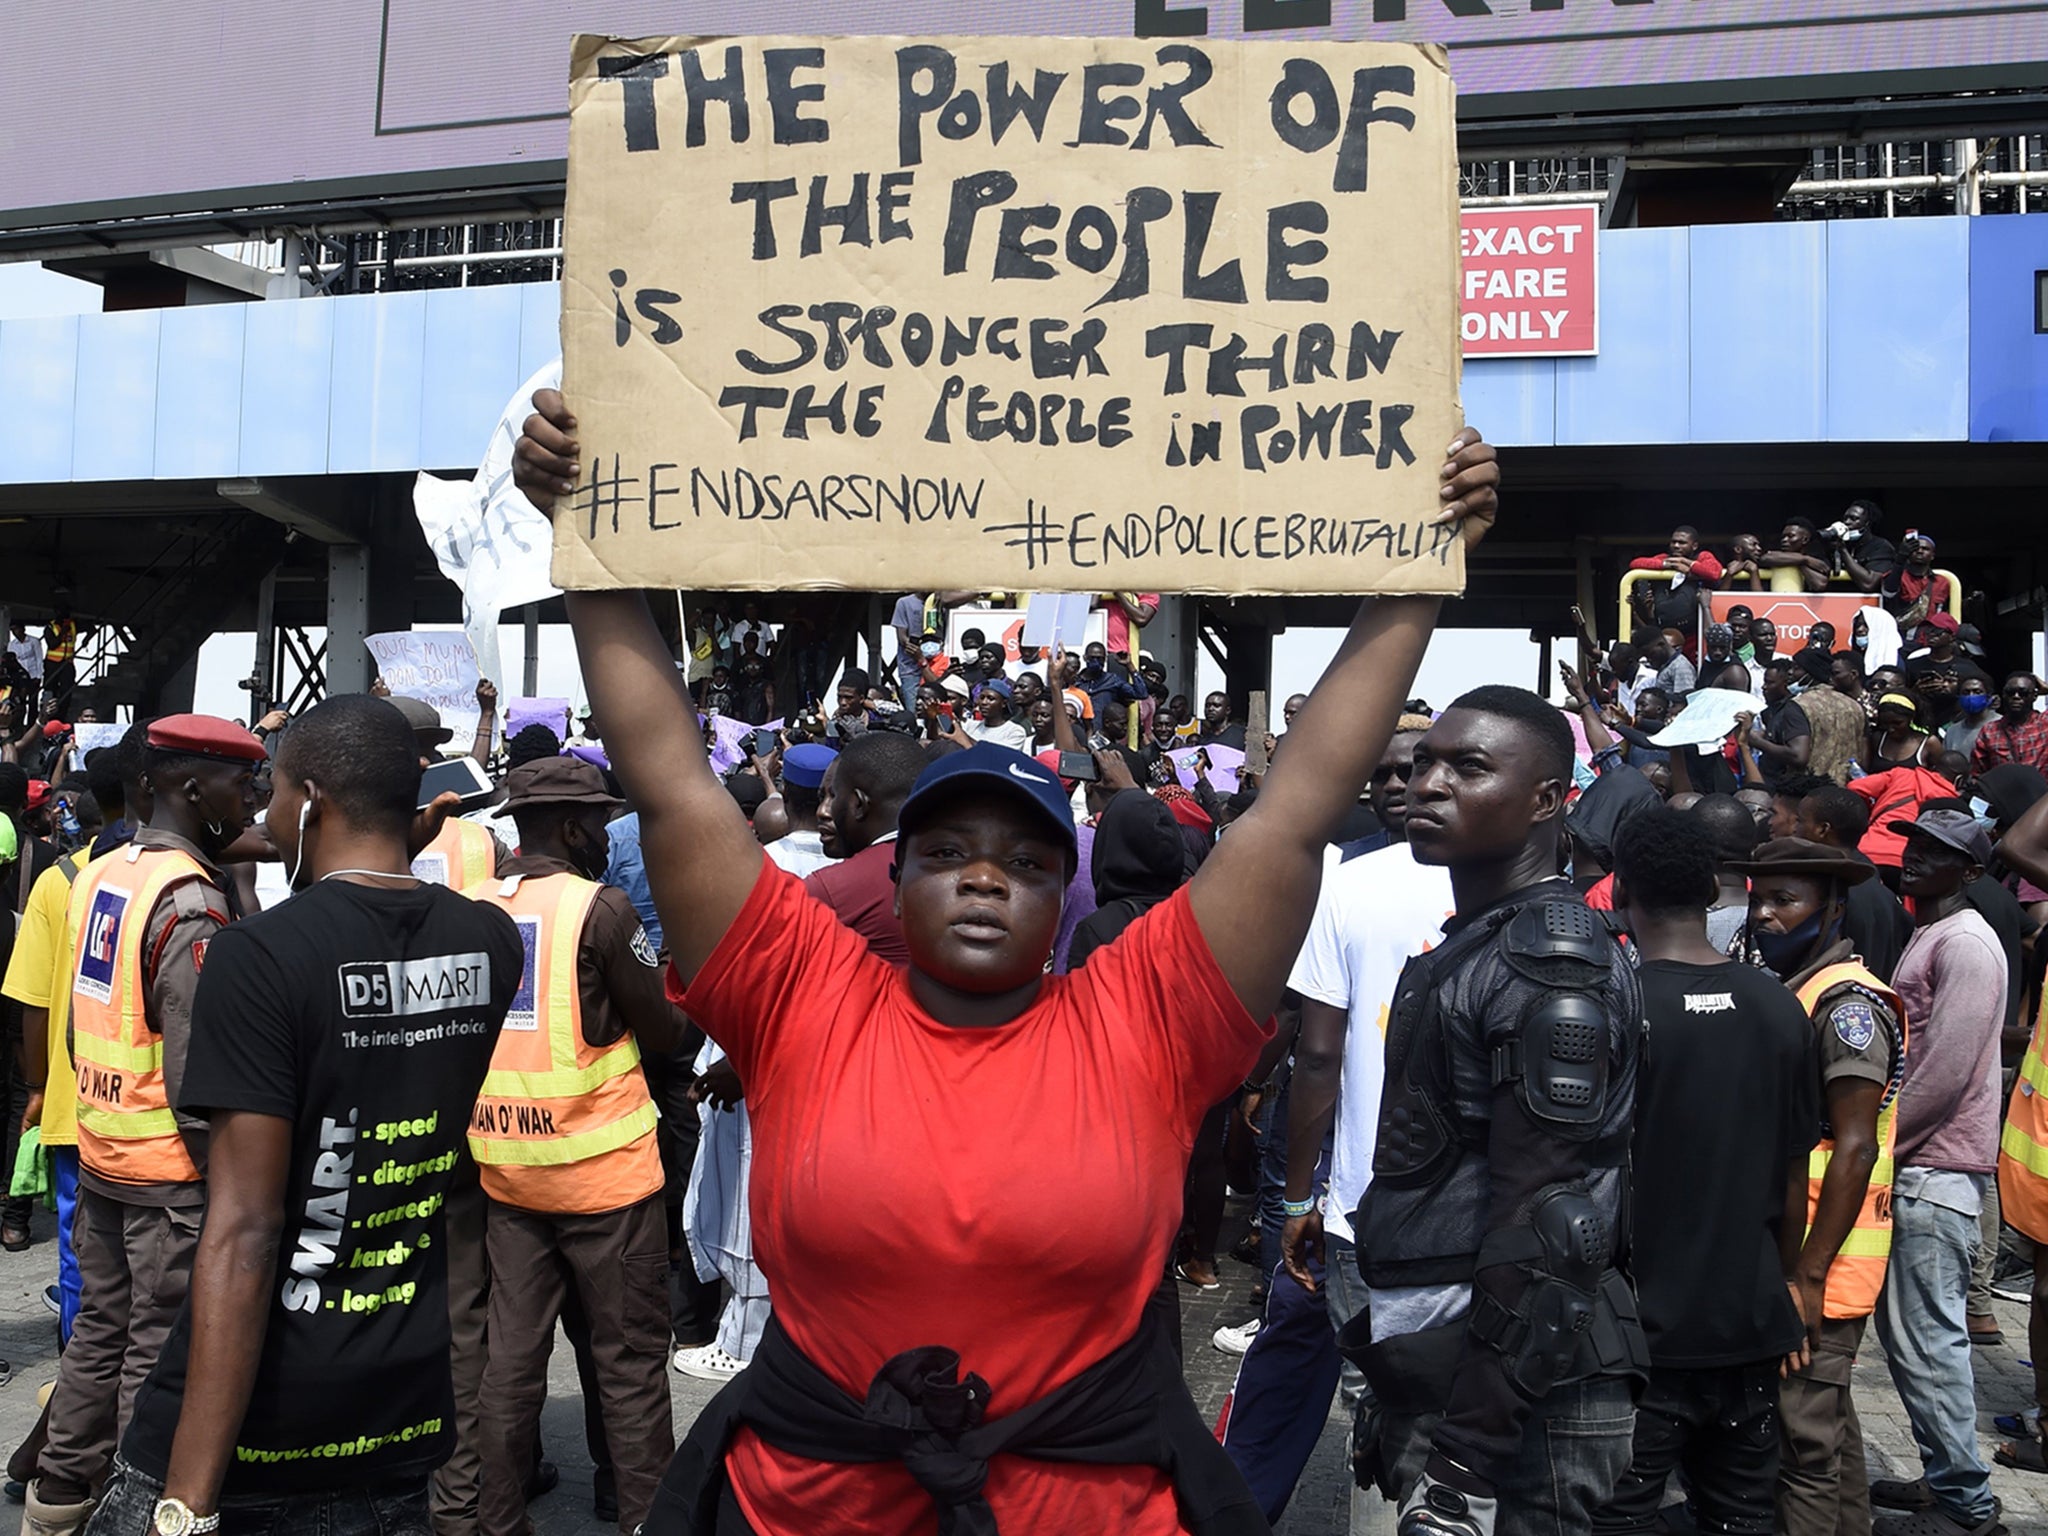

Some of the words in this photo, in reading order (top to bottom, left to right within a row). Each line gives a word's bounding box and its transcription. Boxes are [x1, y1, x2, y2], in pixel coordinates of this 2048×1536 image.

[598, 46, 830, 152] THE
[895, 44, 1224, 167] POWER
[1269, 57, 1416, 193] OF
[730, 171, 915, 260] THE
[943, 170, 1330, 312] PEOPLE
[1461, 225, 1582, 257] EXACT
[1465, 268, 1568, 299] FARE
[736, 301, 1110, 375] STRONGER
[1462, 311, 1570, 341] ONLY
[719, 380, 885, 443] THE
[924, 375, 1133, 447] PEOPLE
[1240, 400, 1417, 473] POWER
[572, 452, 985, 540] #ENDSARSNOW
[982, 498, 1462, 570] #ENDPOLICEBRUTALITY
[375, 637, 416, 661] OUR
[1774, 625, 1812, 640] TOP
[386, 667, 416, 689] DON
[346, 973, 388, 1006] D5
[400, 966, 482, 1005] MART
[342, 1030, 370, 1048] The
[92, 1069, 122, 1103] WAR
[375, 1110, 438, 1146] speed
[516, 1105, 556, 1135] WAR
